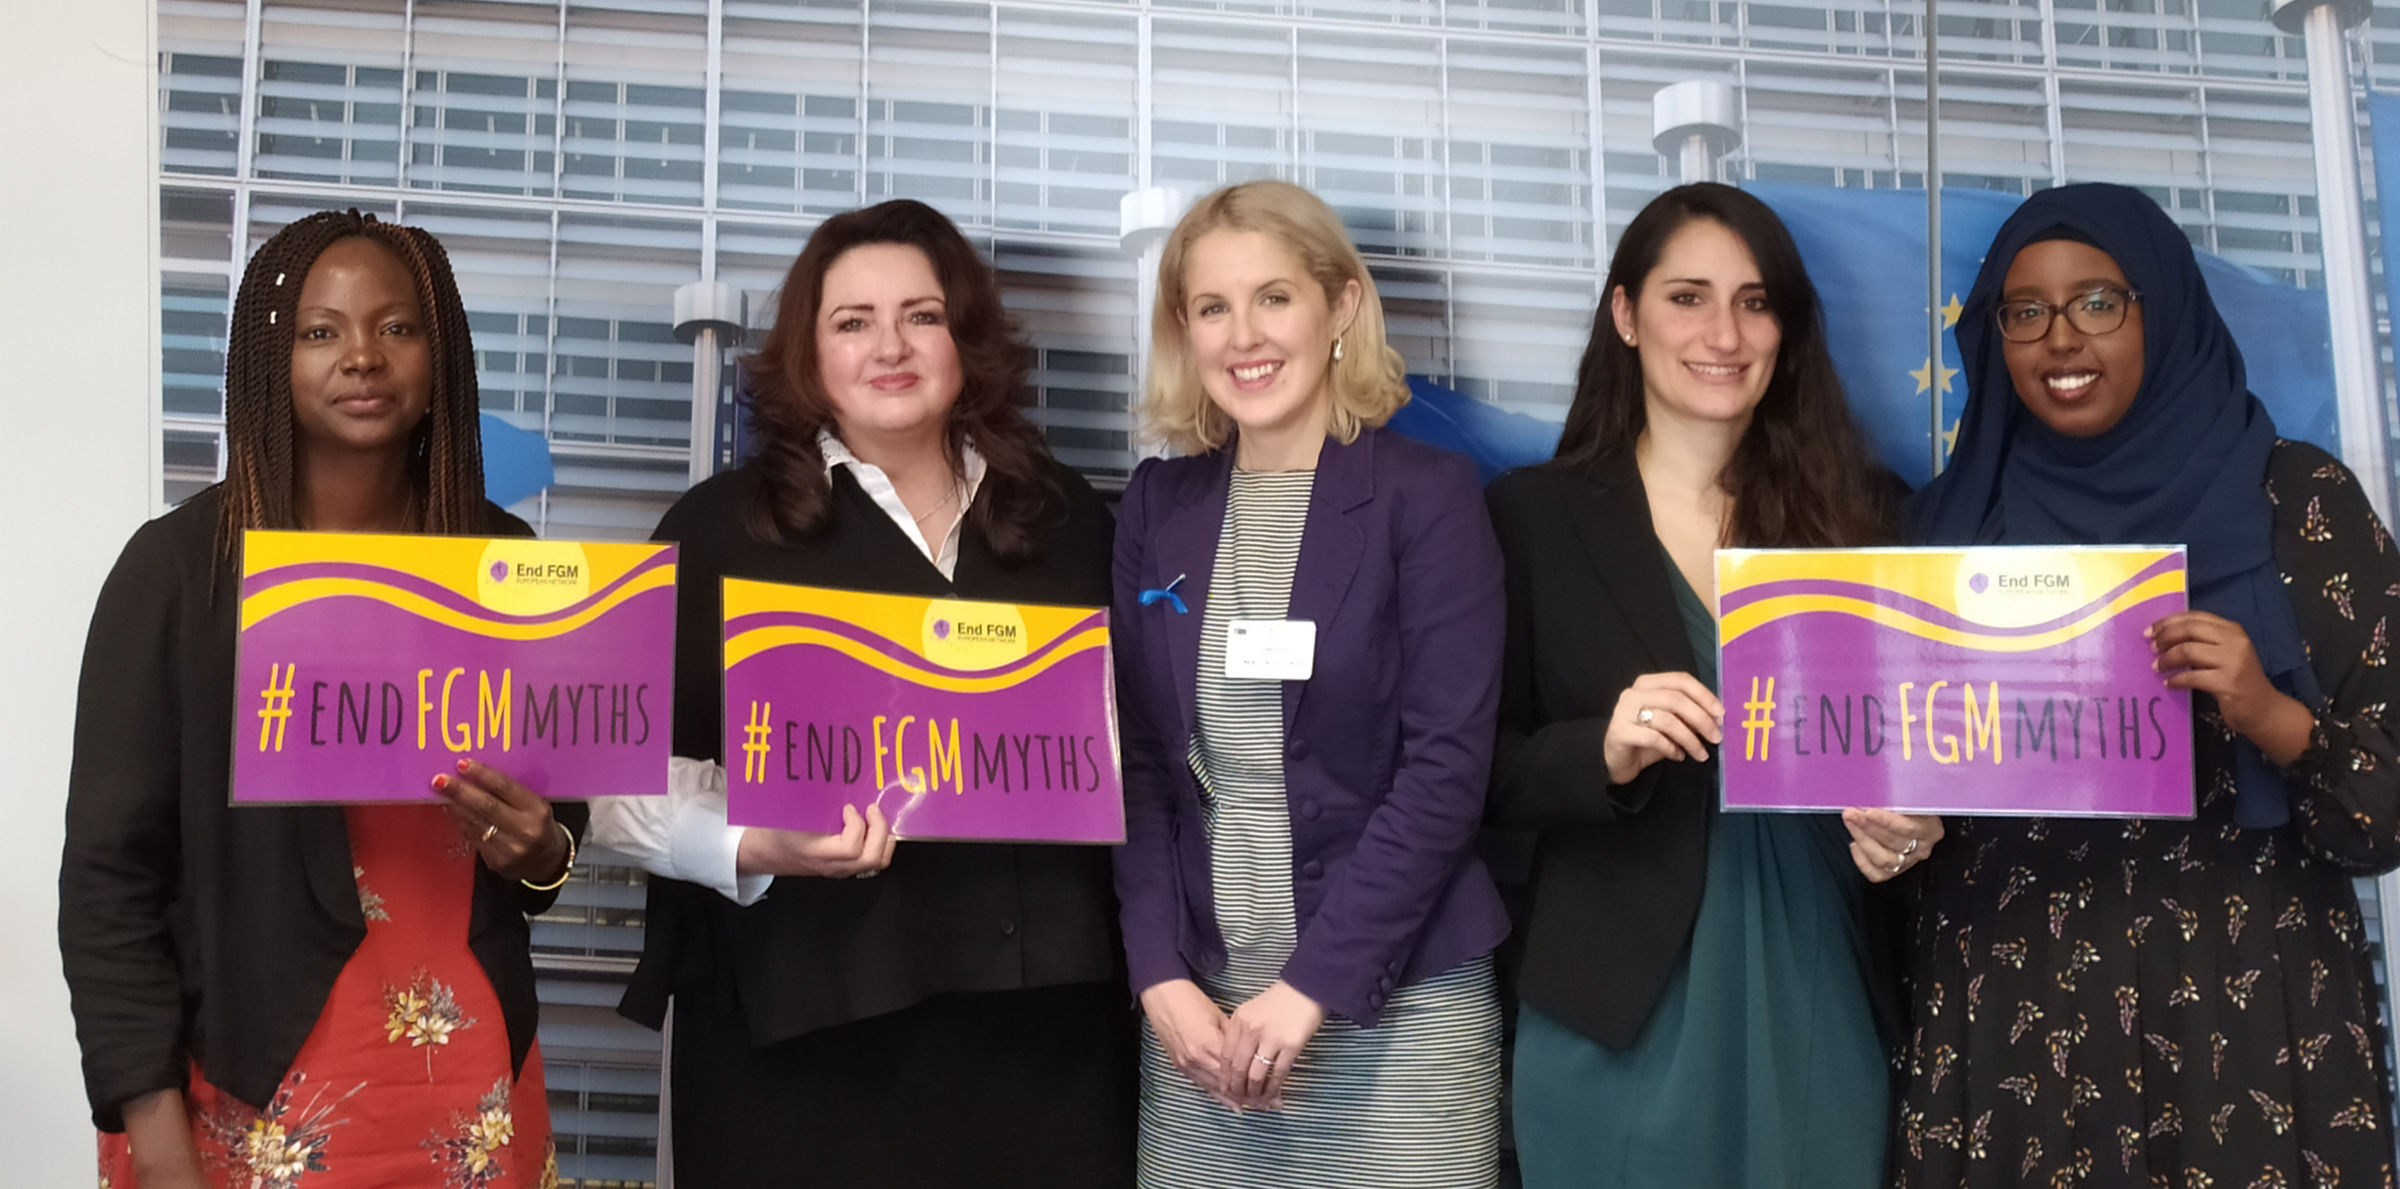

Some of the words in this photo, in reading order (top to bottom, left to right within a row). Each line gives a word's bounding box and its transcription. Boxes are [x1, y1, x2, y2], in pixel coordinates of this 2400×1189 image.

[517, 563, 543, 577] End
[547, 565, 578, 578] FGM
[1998, 575, 2028, 588] End
[2034, 575, 2070, 588] FGM
[957, 622, 983, 636] End
[987, 624, 1017, 638] FGM
